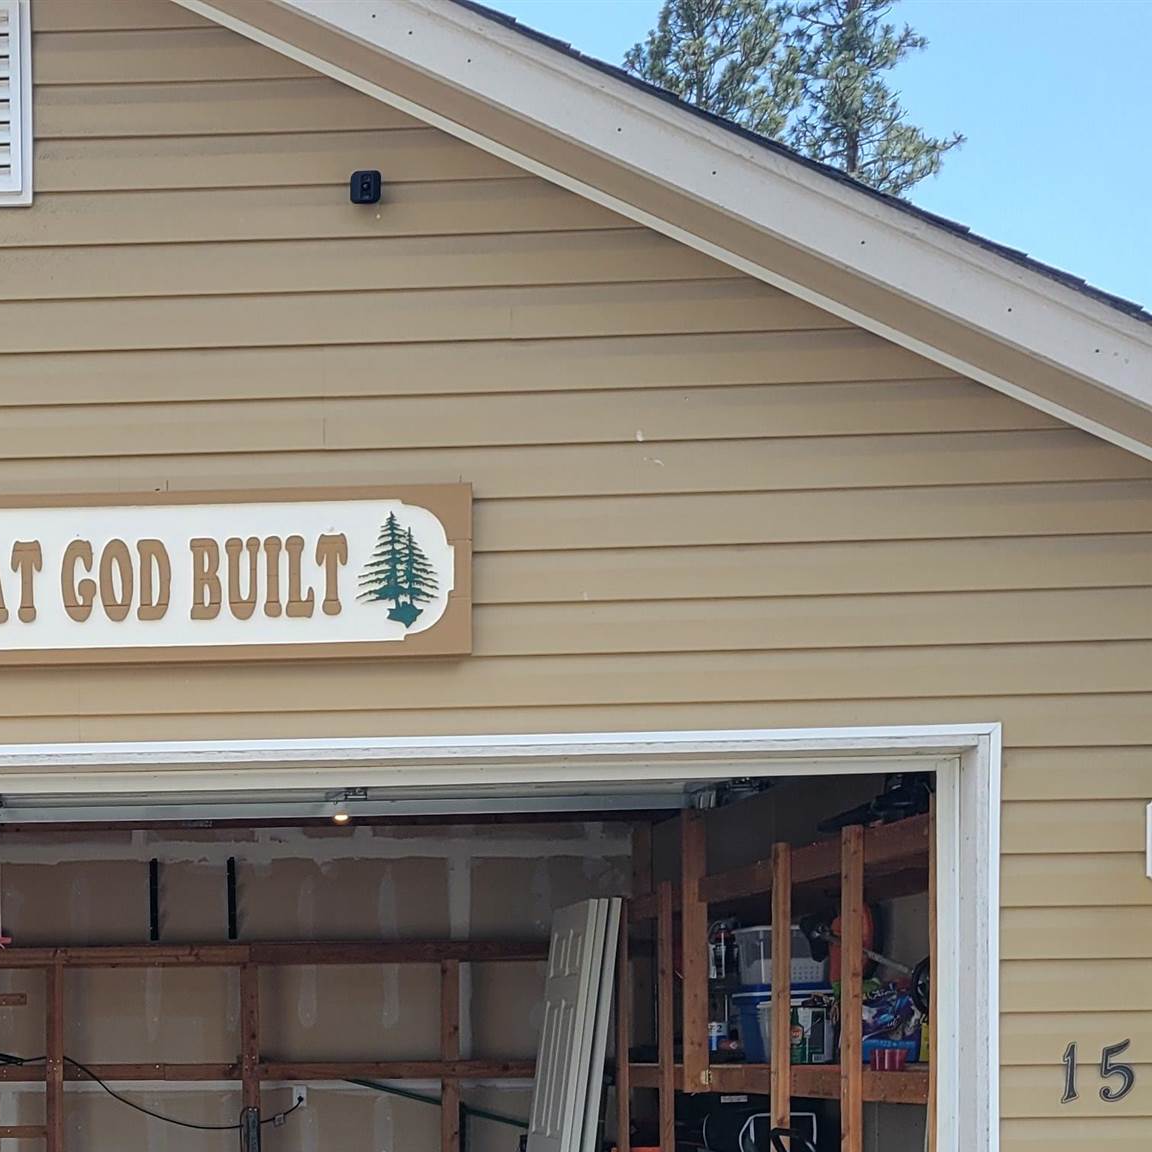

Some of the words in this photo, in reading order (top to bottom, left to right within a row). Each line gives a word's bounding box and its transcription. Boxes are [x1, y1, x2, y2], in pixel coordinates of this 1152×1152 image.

[60, 537, 172, 623] GOD
[189, 532, 348, 620] BUILT
[1060, 1038, 1136, 1104] 15
